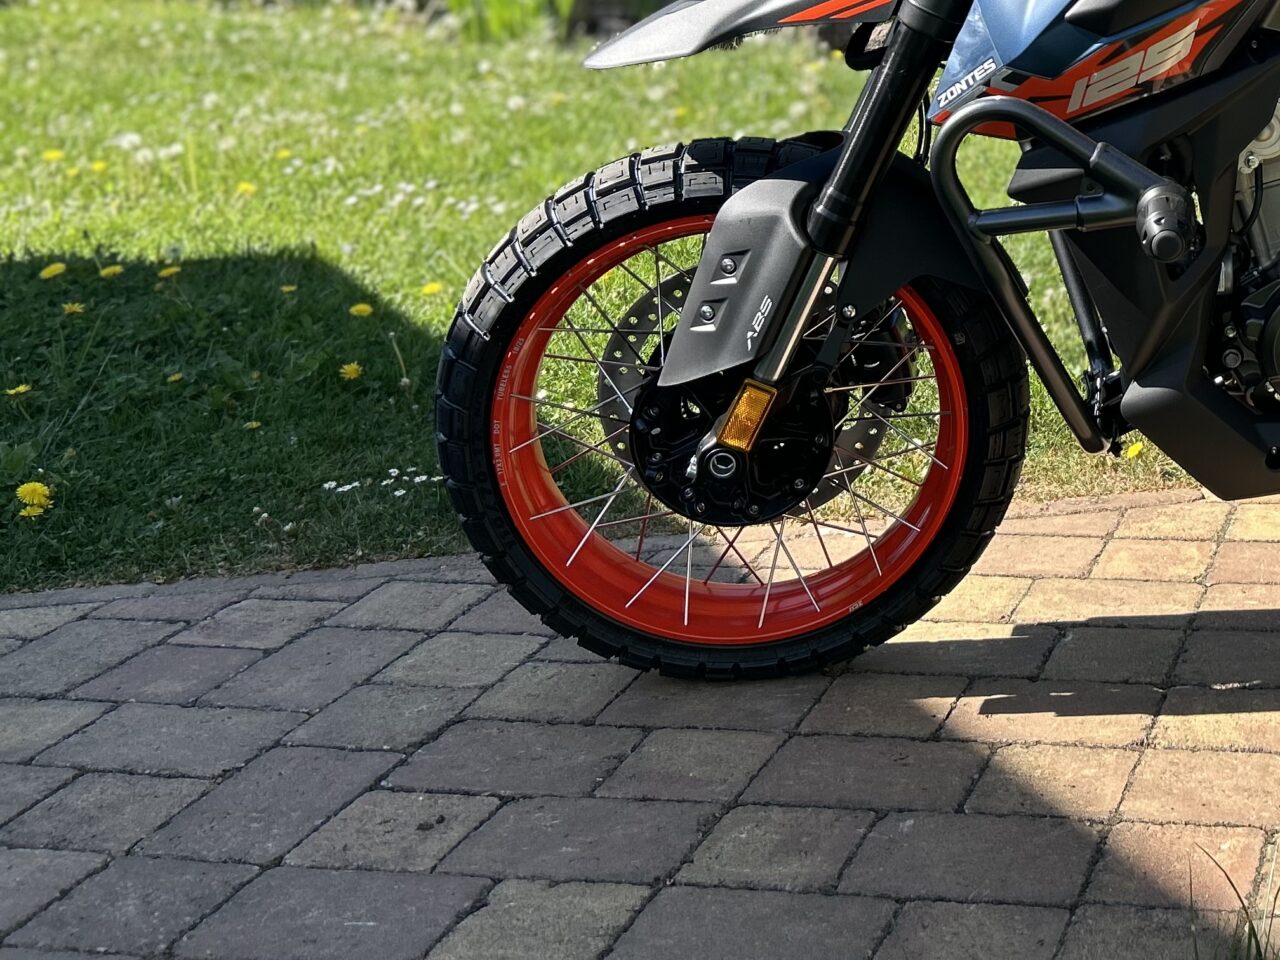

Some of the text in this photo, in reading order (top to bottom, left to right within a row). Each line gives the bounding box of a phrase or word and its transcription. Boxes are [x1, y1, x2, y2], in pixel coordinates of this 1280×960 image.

[937, 58, 997, 108] ZONTES
[1066, 18, 1200, 114] 125
[747, 295, 772, 351] ABS
[496, 363, 512, 400] TUBELESS
[493, 419, 501, 434] DOT
